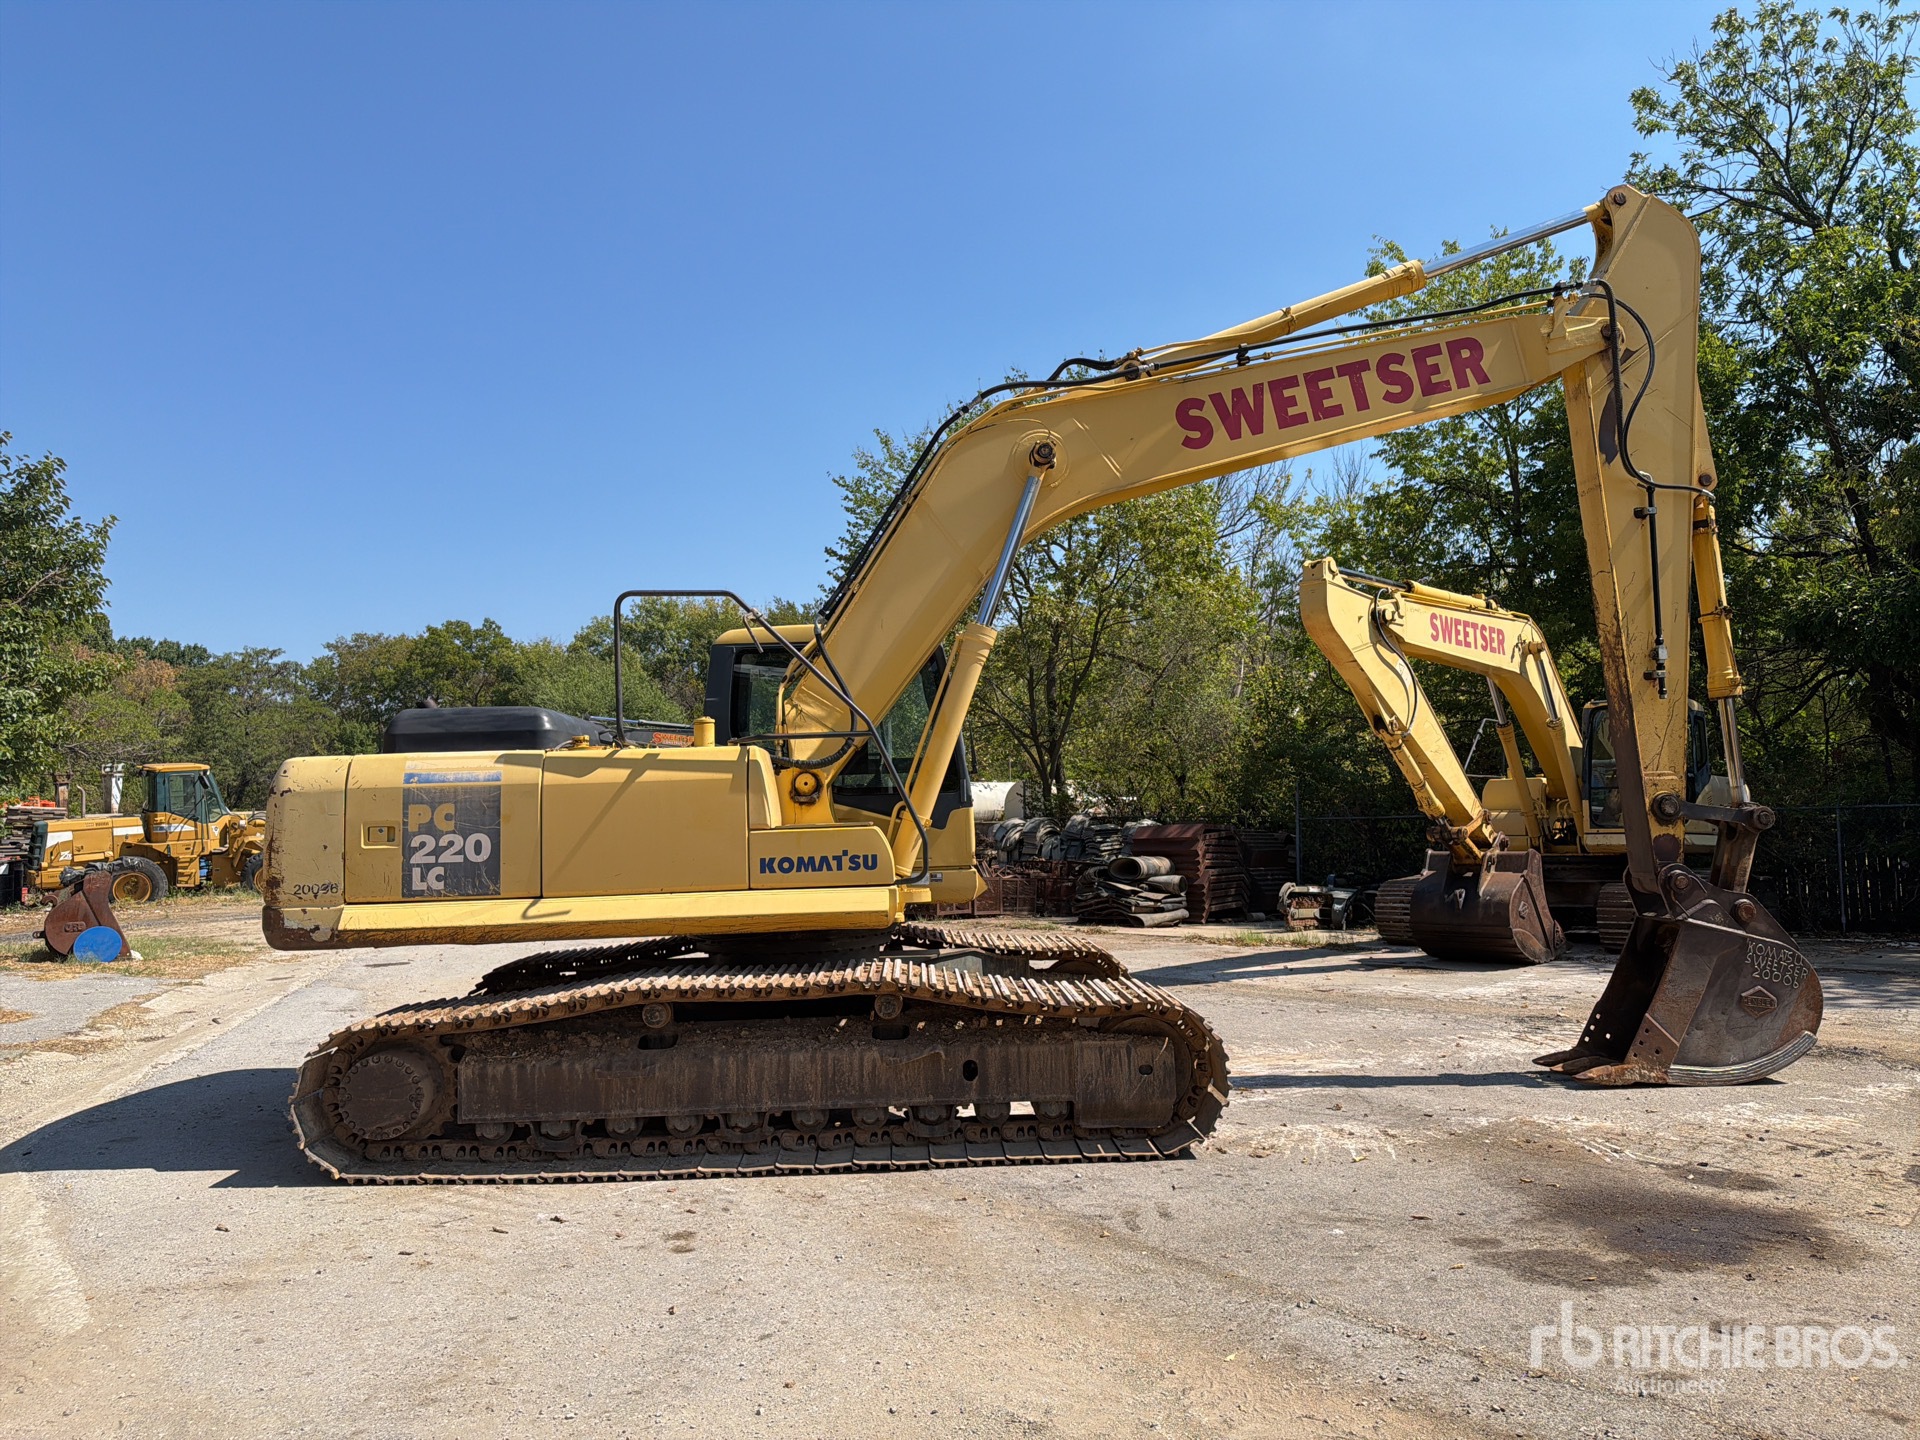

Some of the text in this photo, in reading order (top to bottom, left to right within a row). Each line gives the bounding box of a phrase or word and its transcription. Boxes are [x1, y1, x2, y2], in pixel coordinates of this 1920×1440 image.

[1175, 337, 1491, 449] SWEETSER
[1429, 612, 1506, 656] SWEETSER
[408, 803, 455, 832] PC
[410, 833, 492, 864] 220
[760, 850, 878, 874] KOMATSU
[412, 866, 445, 890] LC
[1745, 953, 1809, 979] SWEETSER
[1746, 940, 1803, 966] KOMATSU
[1752, 966, 1799, 989] 20006
